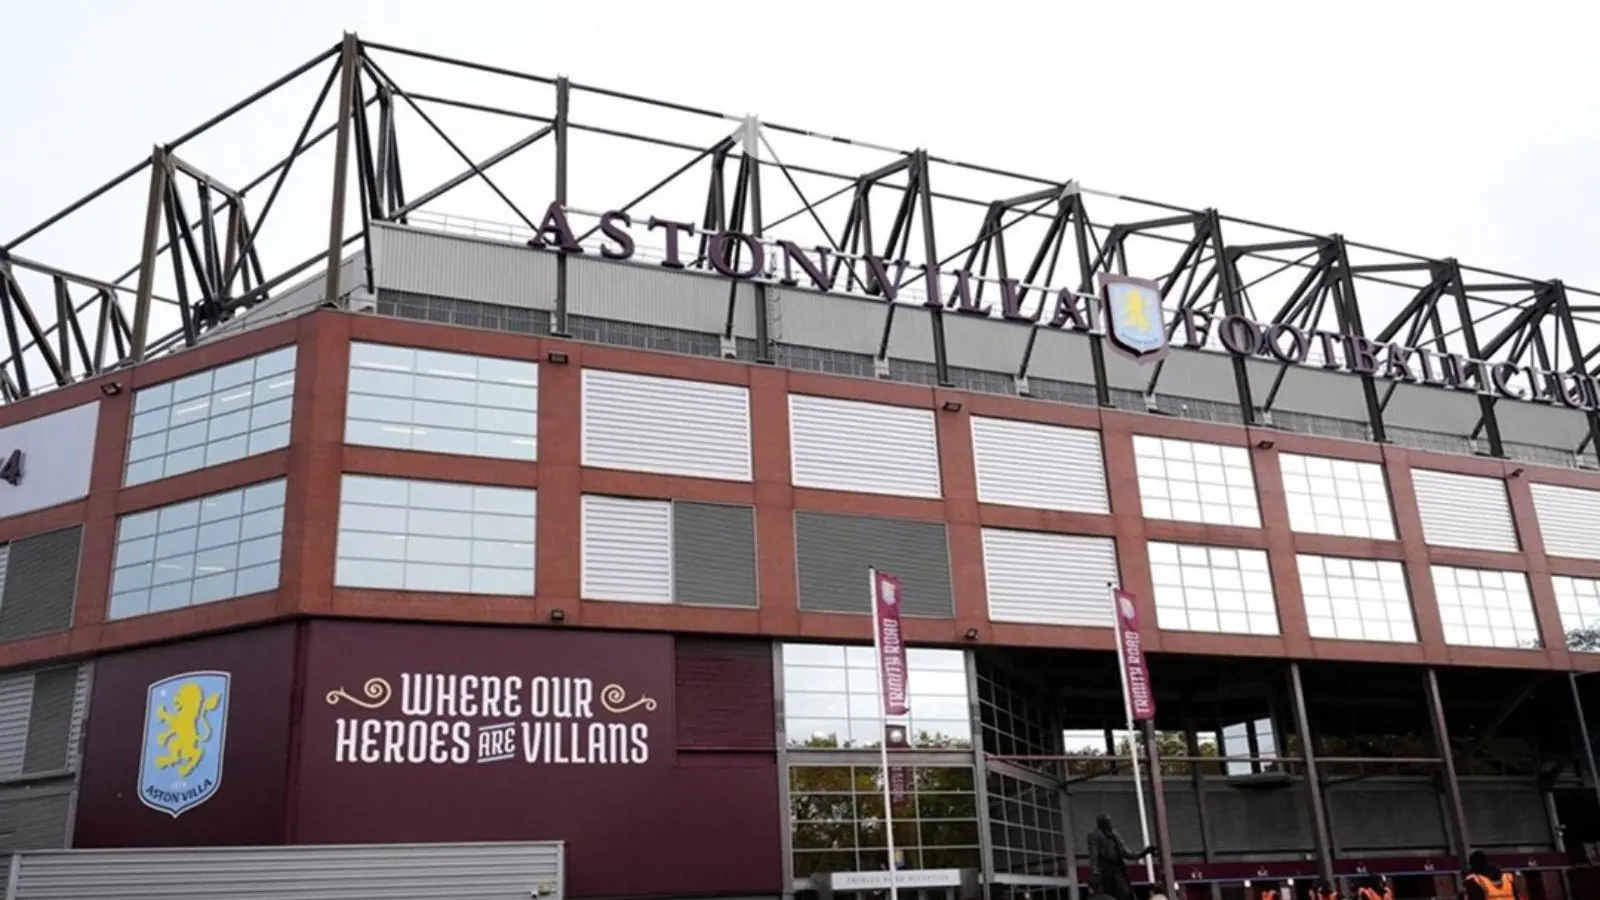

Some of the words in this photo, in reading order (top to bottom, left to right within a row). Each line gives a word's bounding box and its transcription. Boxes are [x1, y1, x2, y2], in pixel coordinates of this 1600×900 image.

[527, 200, 831, 291] ASTON
[862, 254, 1090, 332] VILLA
[1178, 306, 1478, 393] FOOTBALL
[883, 618, 900, 654] ROAD
[1124, 631, 1141, 664] ROAD
[401, 672, 523, 717] WHERE
[531, 676, 594, 718] OUR
[884, 656, 905, 709] TRINITY
[1129, 666, 1151, 713] TRINITY
[335, 718, 471, 763] HEROES
[478, 727, 516, 757] ARE
[521, 721, 649, 764] VILLANS
[145, 784, 180, 804] ASTON
[181, 777, 213, 801] VILLA
